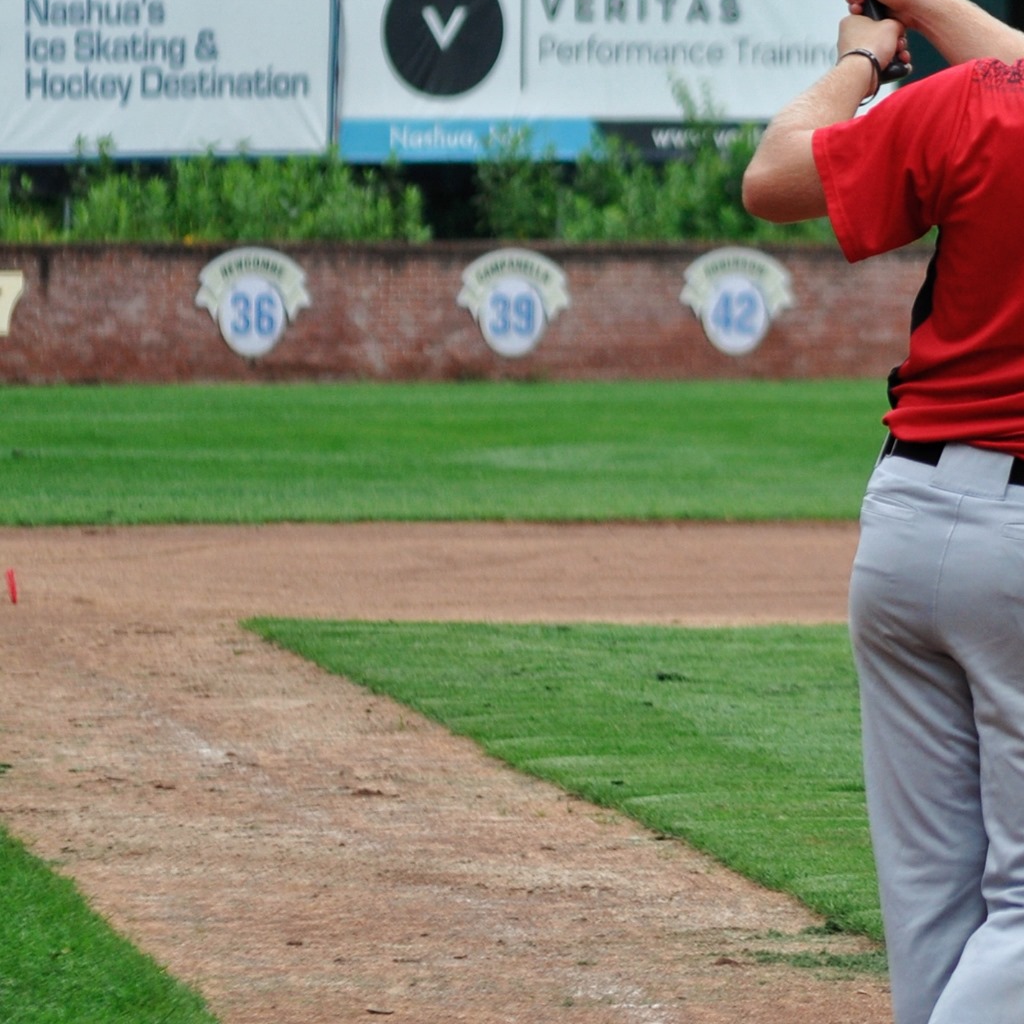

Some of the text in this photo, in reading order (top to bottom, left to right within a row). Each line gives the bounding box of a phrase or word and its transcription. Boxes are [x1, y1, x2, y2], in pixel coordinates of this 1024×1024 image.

[24, 29, 219, 70] Ice Skating &
[538, 33, 726, 67] Performance
[24, 65, 311, 107] Hockey Destination
[230, 291, 276, 336] 36
[489, 291, 535, 336] 39
[710, 290, 758, 335] 42
